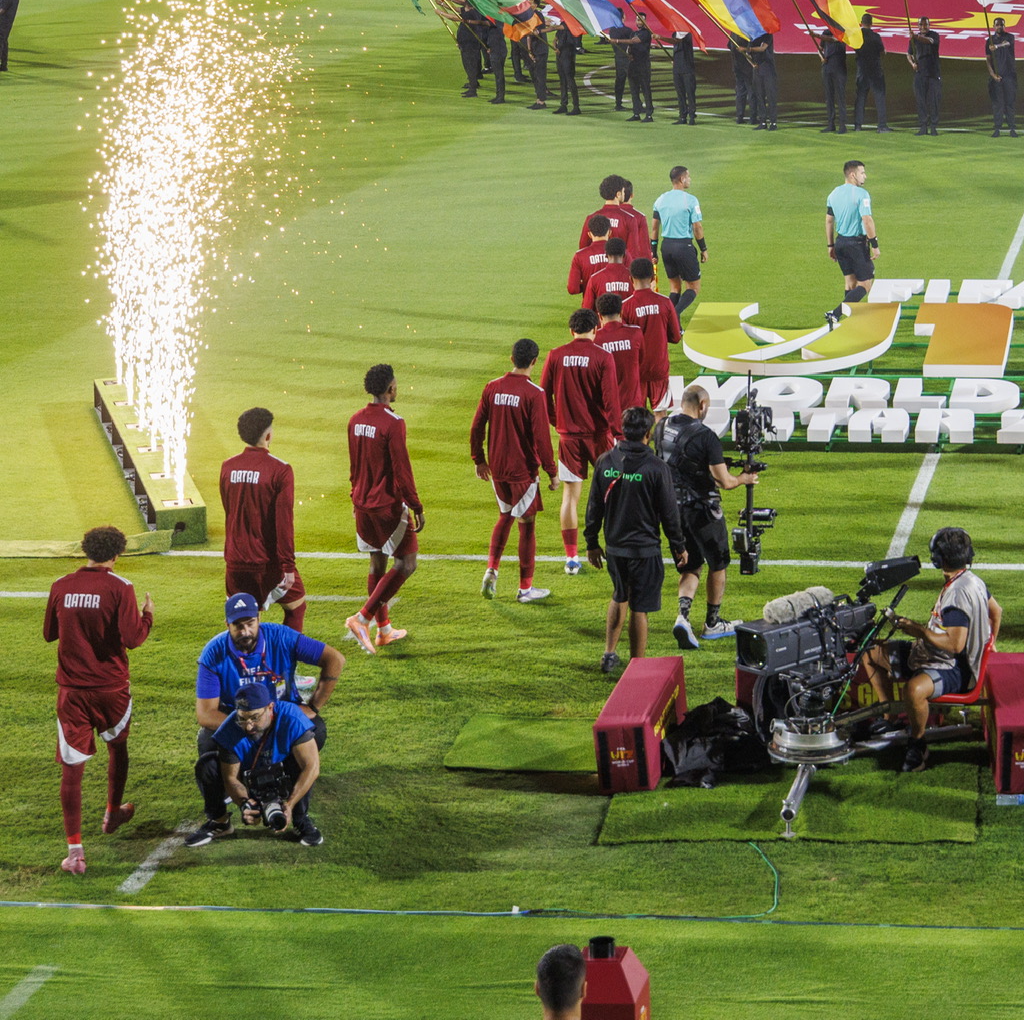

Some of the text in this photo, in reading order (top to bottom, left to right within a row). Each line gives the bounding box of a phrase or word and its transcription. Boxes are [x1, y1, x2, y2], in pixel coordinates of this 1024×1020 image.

[605, 281, 630, 293] QATAR
[635, 304, 660, 318] QATAR
[602, 339, 632, 353] QATAR
[562, 355, 590, 368] QATAR
[494, 392, 521, 408] QATAR
[354, 423, 377, 439] QATAR
[230, 469, 260, 485] QATAR
[64, 593, 100, 609] QATAR
